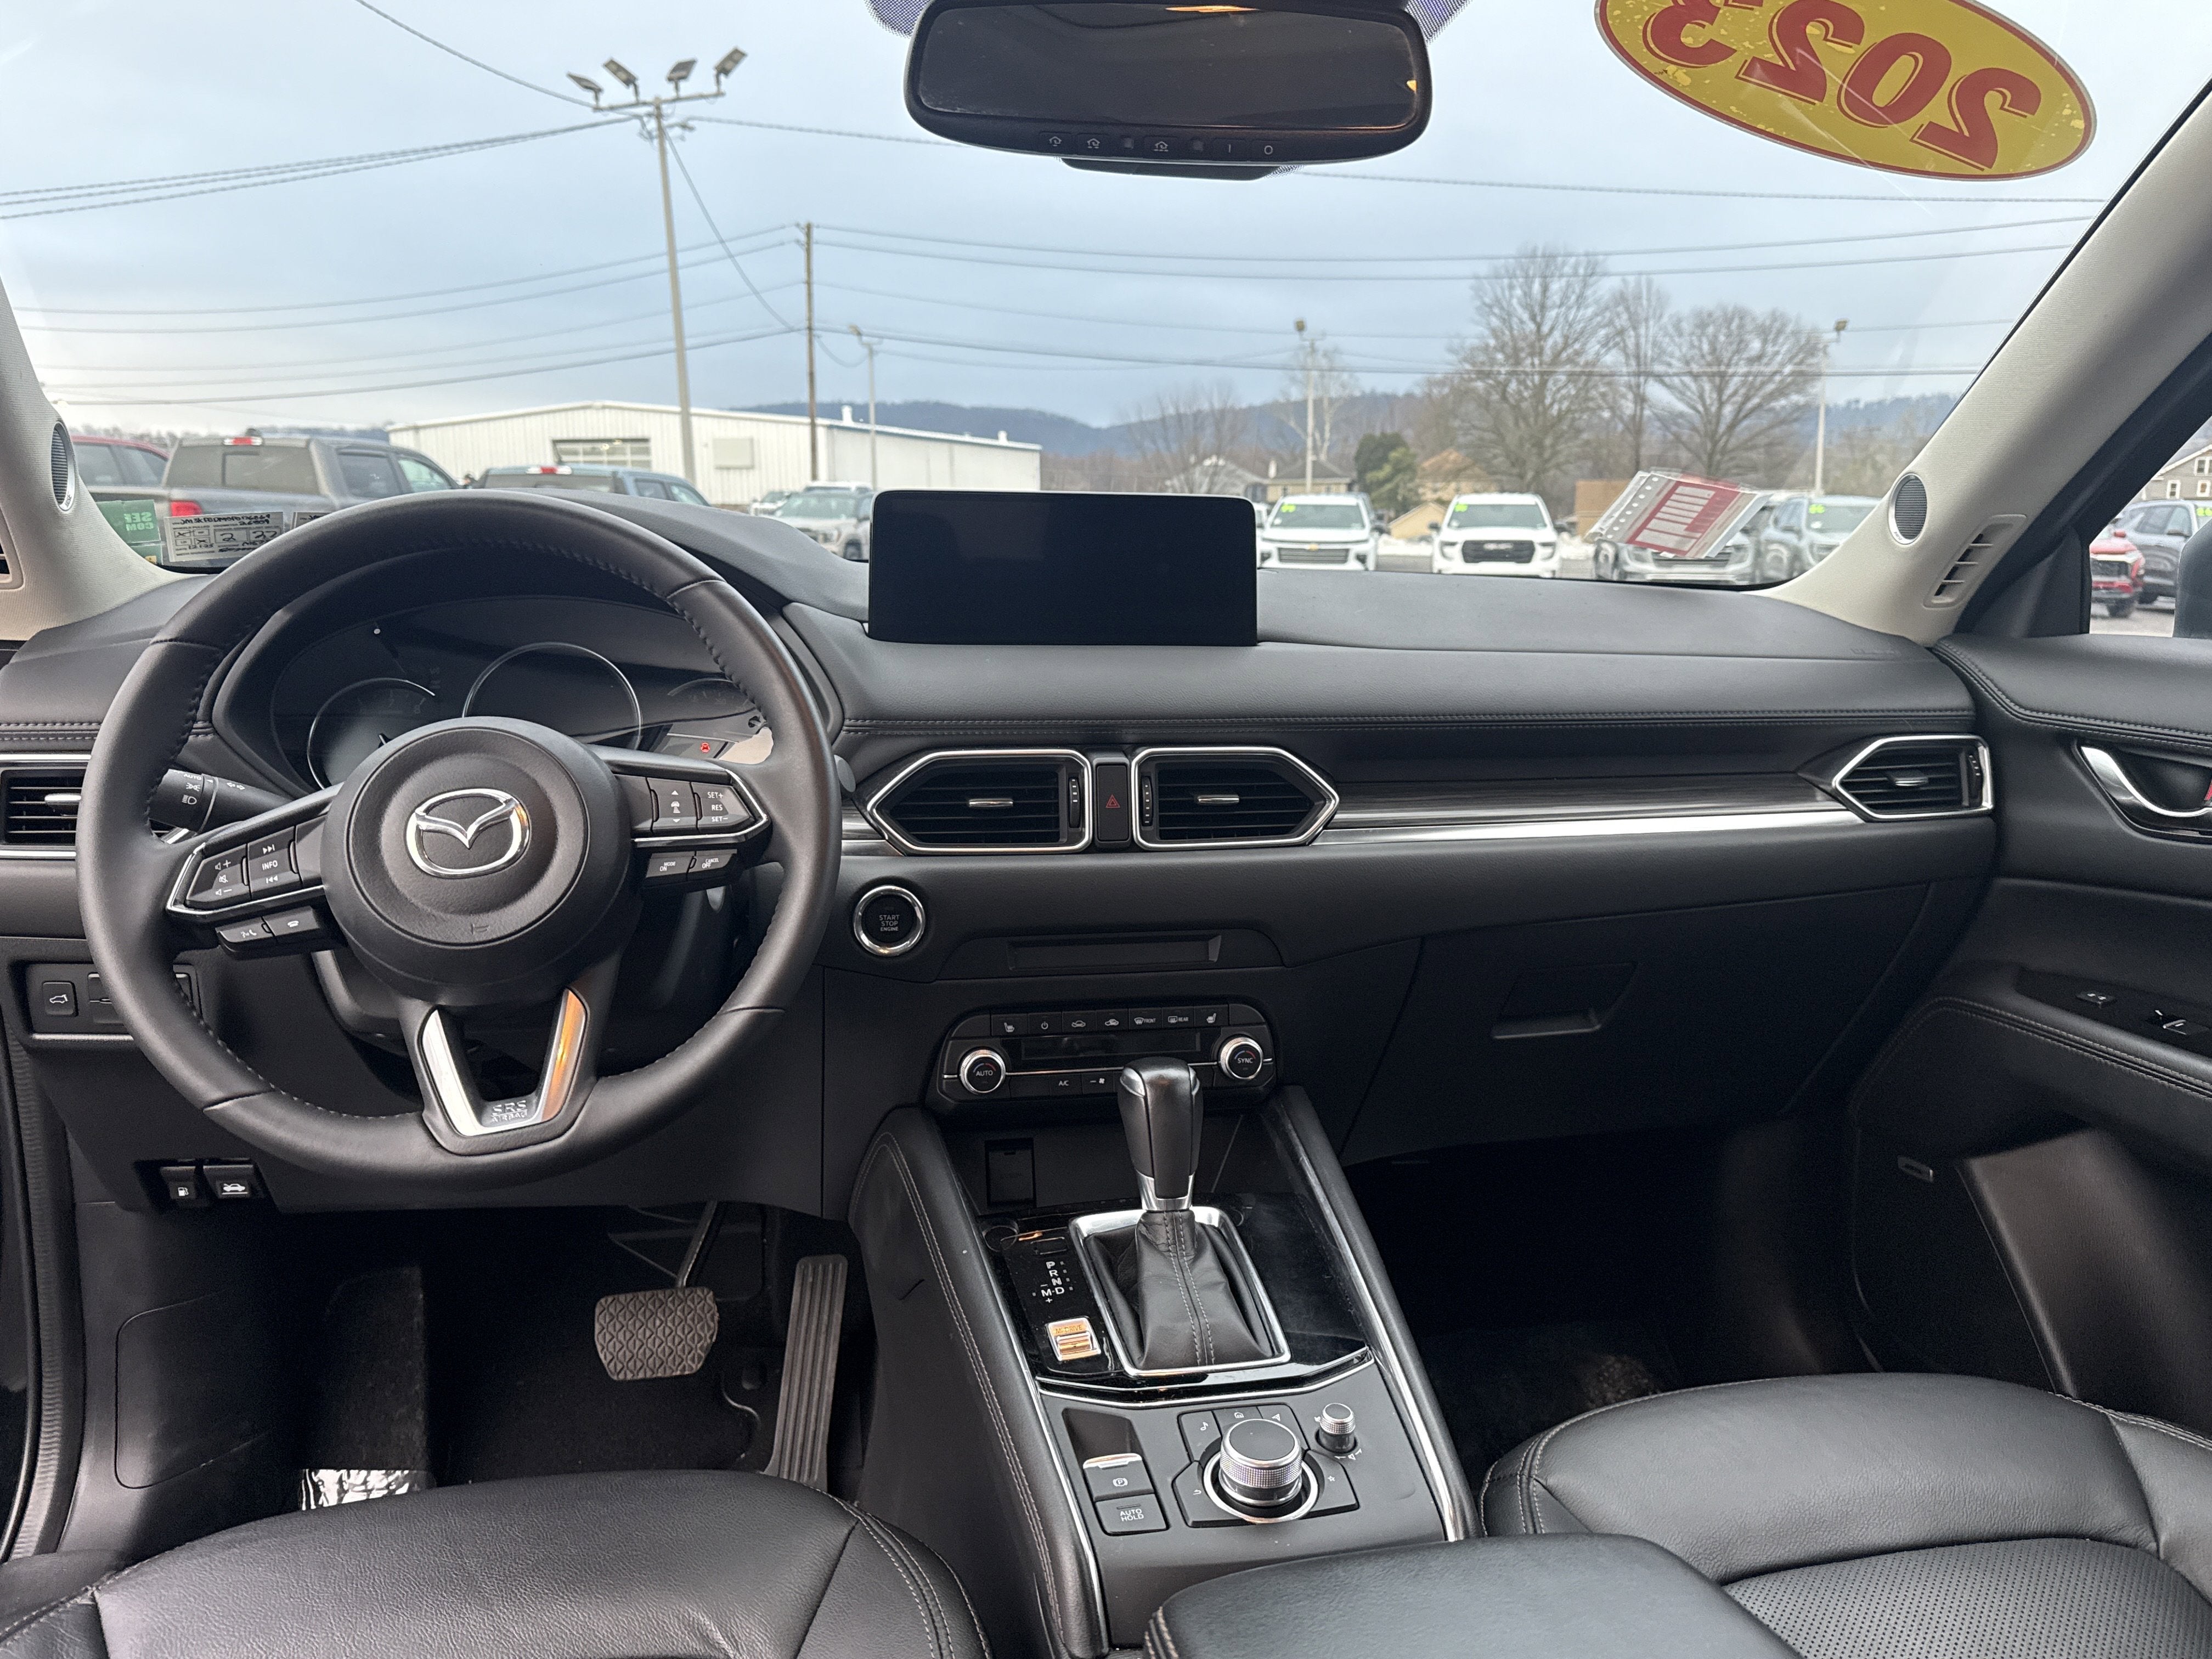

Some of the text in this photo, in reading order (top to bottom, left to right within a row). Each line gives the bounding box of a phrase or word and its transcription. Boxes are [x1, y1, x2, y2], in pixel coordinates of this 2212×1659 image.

[262, 860, 278, 871] INFO
[492, 1100, 527, 1115] SRS
[491, 1110, 528, 1123] AIRBAG
[1046, 1261, 1056, 1269] P
[1051, 1277, 1063, 1286] N
[1120, 1508, 1142, 1516] AUTO
[1121, 1514, 1144, 1522] HOLD
